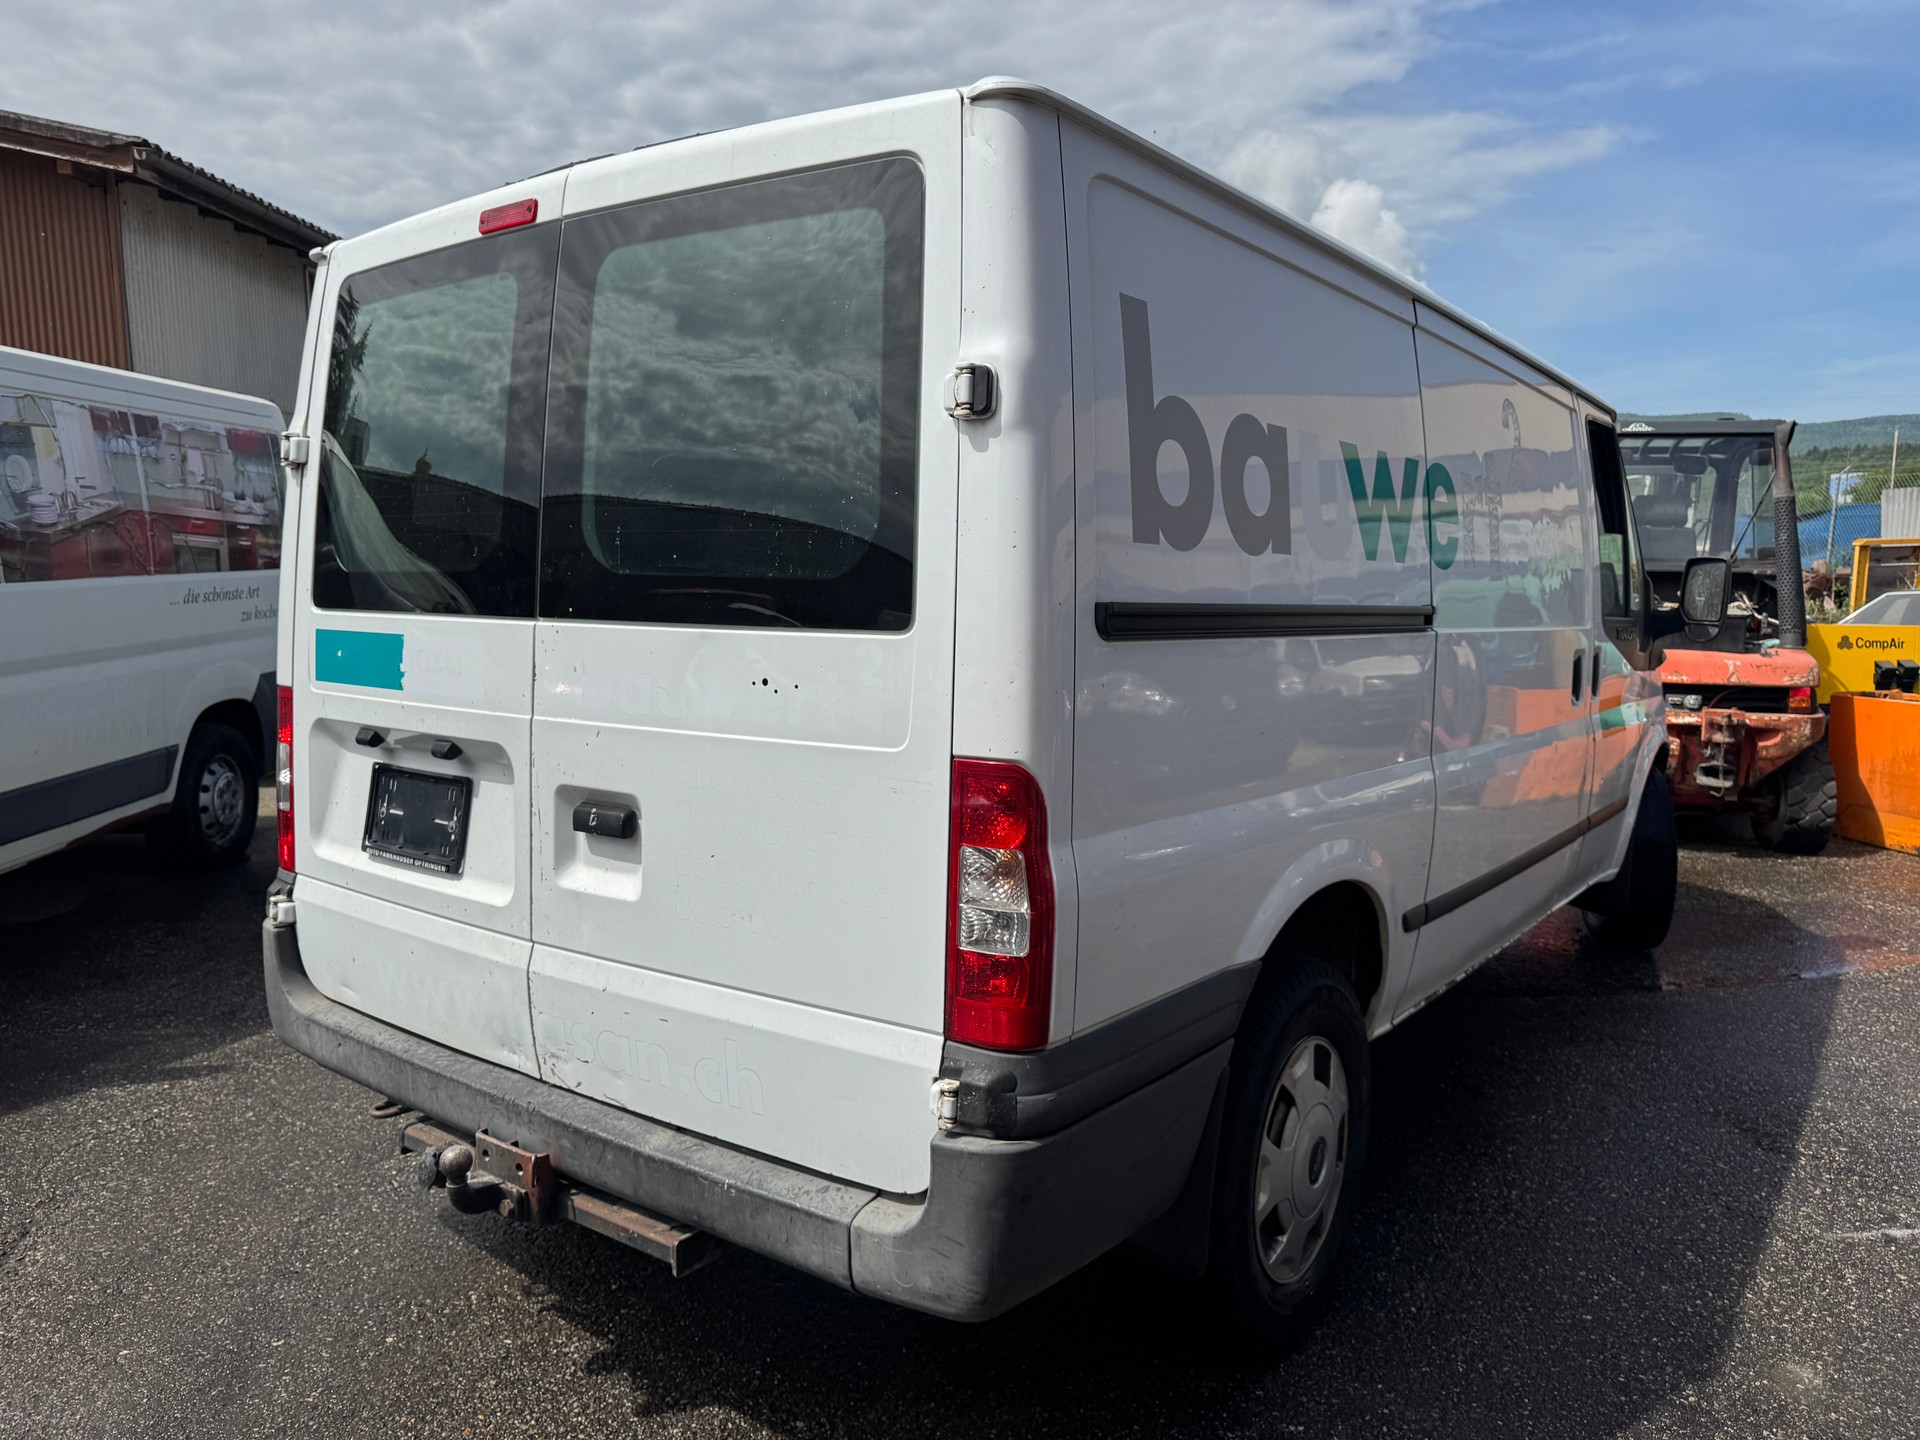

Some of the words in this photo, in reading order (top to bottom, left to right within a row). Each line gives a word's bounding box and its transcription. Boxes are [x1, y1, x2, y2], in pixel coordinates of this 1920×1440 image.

[183, 588, 200, 605] die
[202, 586, 244, 604] schönste
[245, 585, 260, 599] Art
[241, 611, 252, 622] zu
[1856, 637, 1905, 651] CompAir
[366, 847, 379, 856] AUTO
